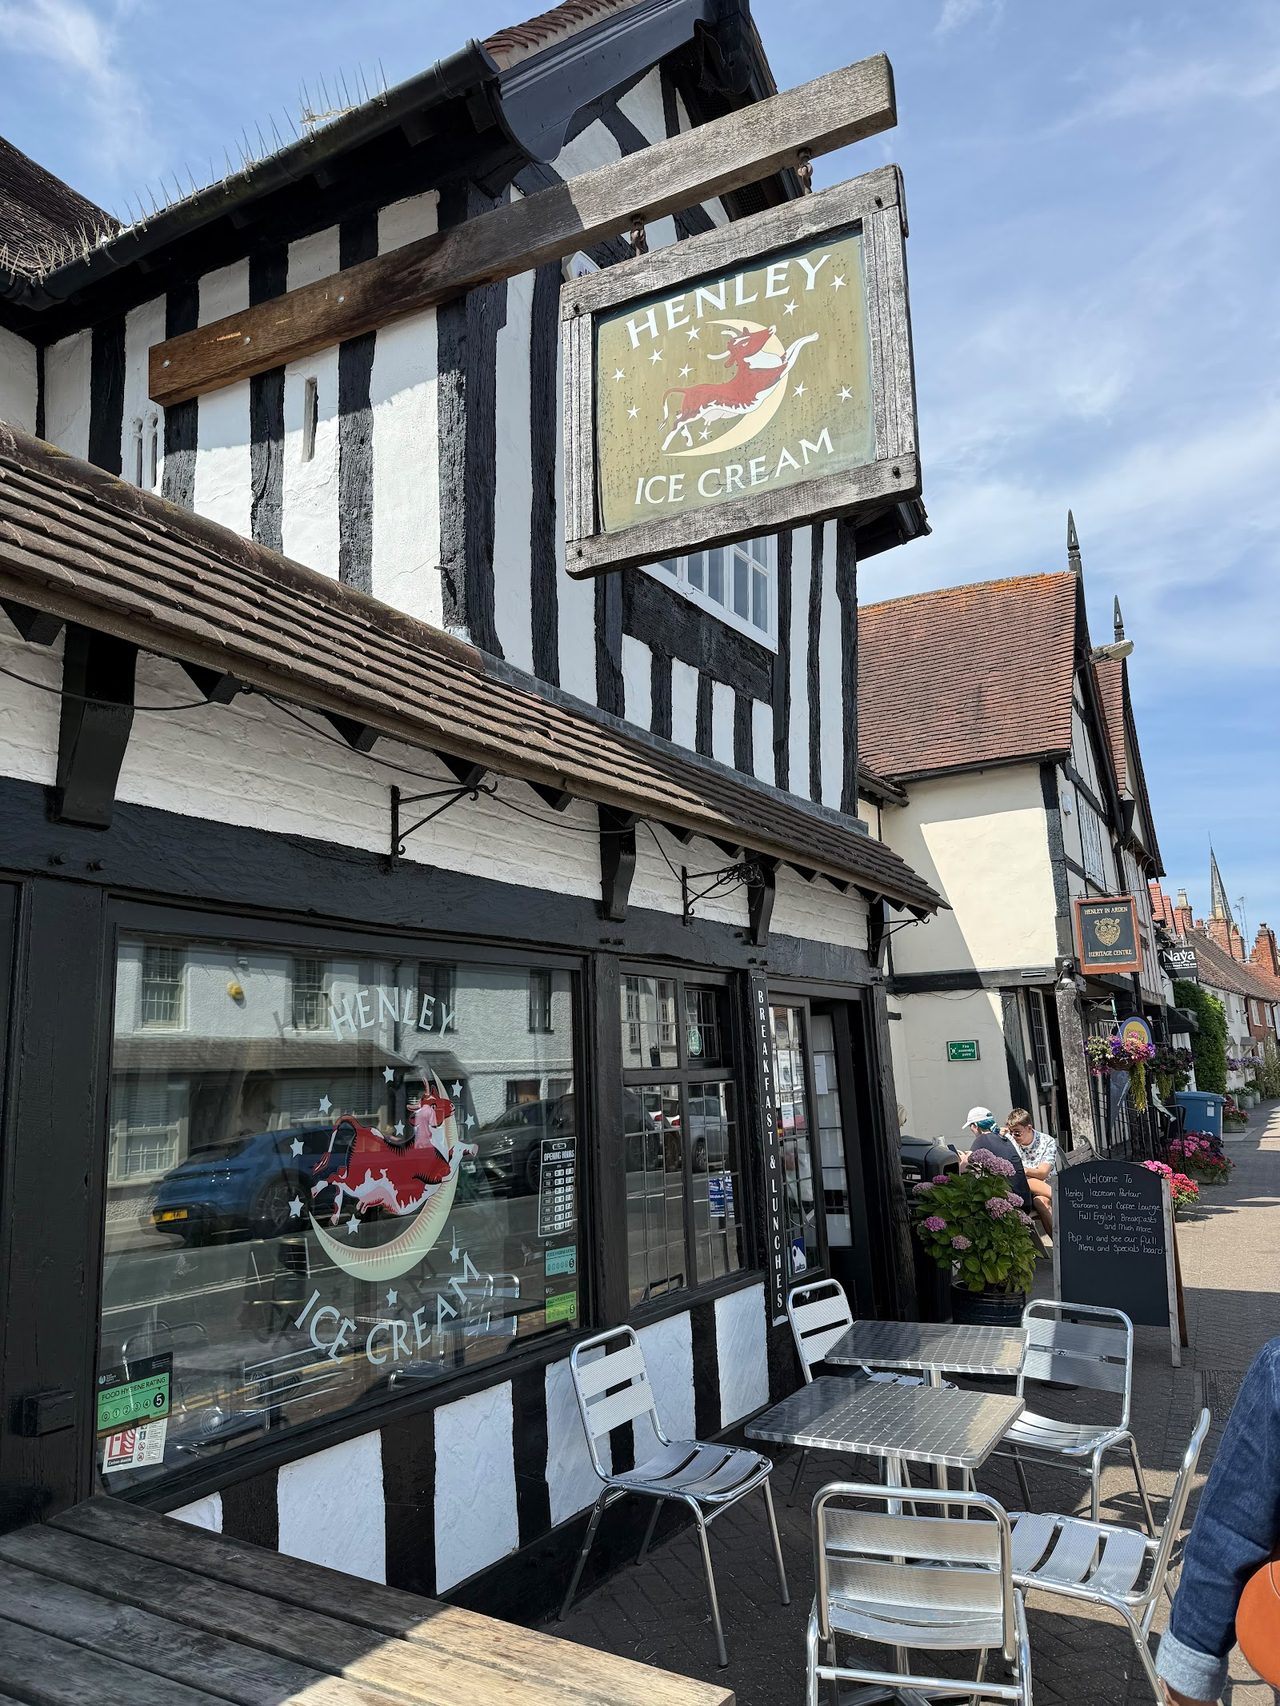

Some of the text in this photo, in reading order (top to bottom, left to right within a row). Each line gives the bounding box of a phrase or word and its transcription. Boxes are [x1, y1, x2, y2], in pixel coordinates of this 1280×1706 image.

[626, 254, 832, 350] HENLEY
[634, 427, 836, 506] ICE CREAM
[1113, 949, 1132, 957] CENTRE
[1162, 949, 1196, 964] Naya
[328, 986, 457, 1042] HENLEY
[544, 1150, 575, 1162] OPENING HOURS
[757, 990, 783, 1308] BREAKFAST & LUNCHES
[1082, 1172, 1133, 1184] Welcome To
[1065, 1187, 1084, 1201] Henley
[1119, 1187, 1142, 1198] Parlour
[1069, 1200, 1099, 1209] Tearooms
[1138, 1202, 1162, 1216] Lounge
[1078, 1210, 1091, 1220] Full
[1094, 1211, 1116, 1225] English
[1104, 1223, 1116, 1231] and
[1068, 1231, 1082, 1244] Pop
[1097, 1244, 1110, 1252] and
[294, 1250, 481, 1366] ICE CREAM
[101, 1390, 120, 1401] FOOD
[145, 1376, 166, 1390] RATING
[155, 1394, 163, 1406] 5
